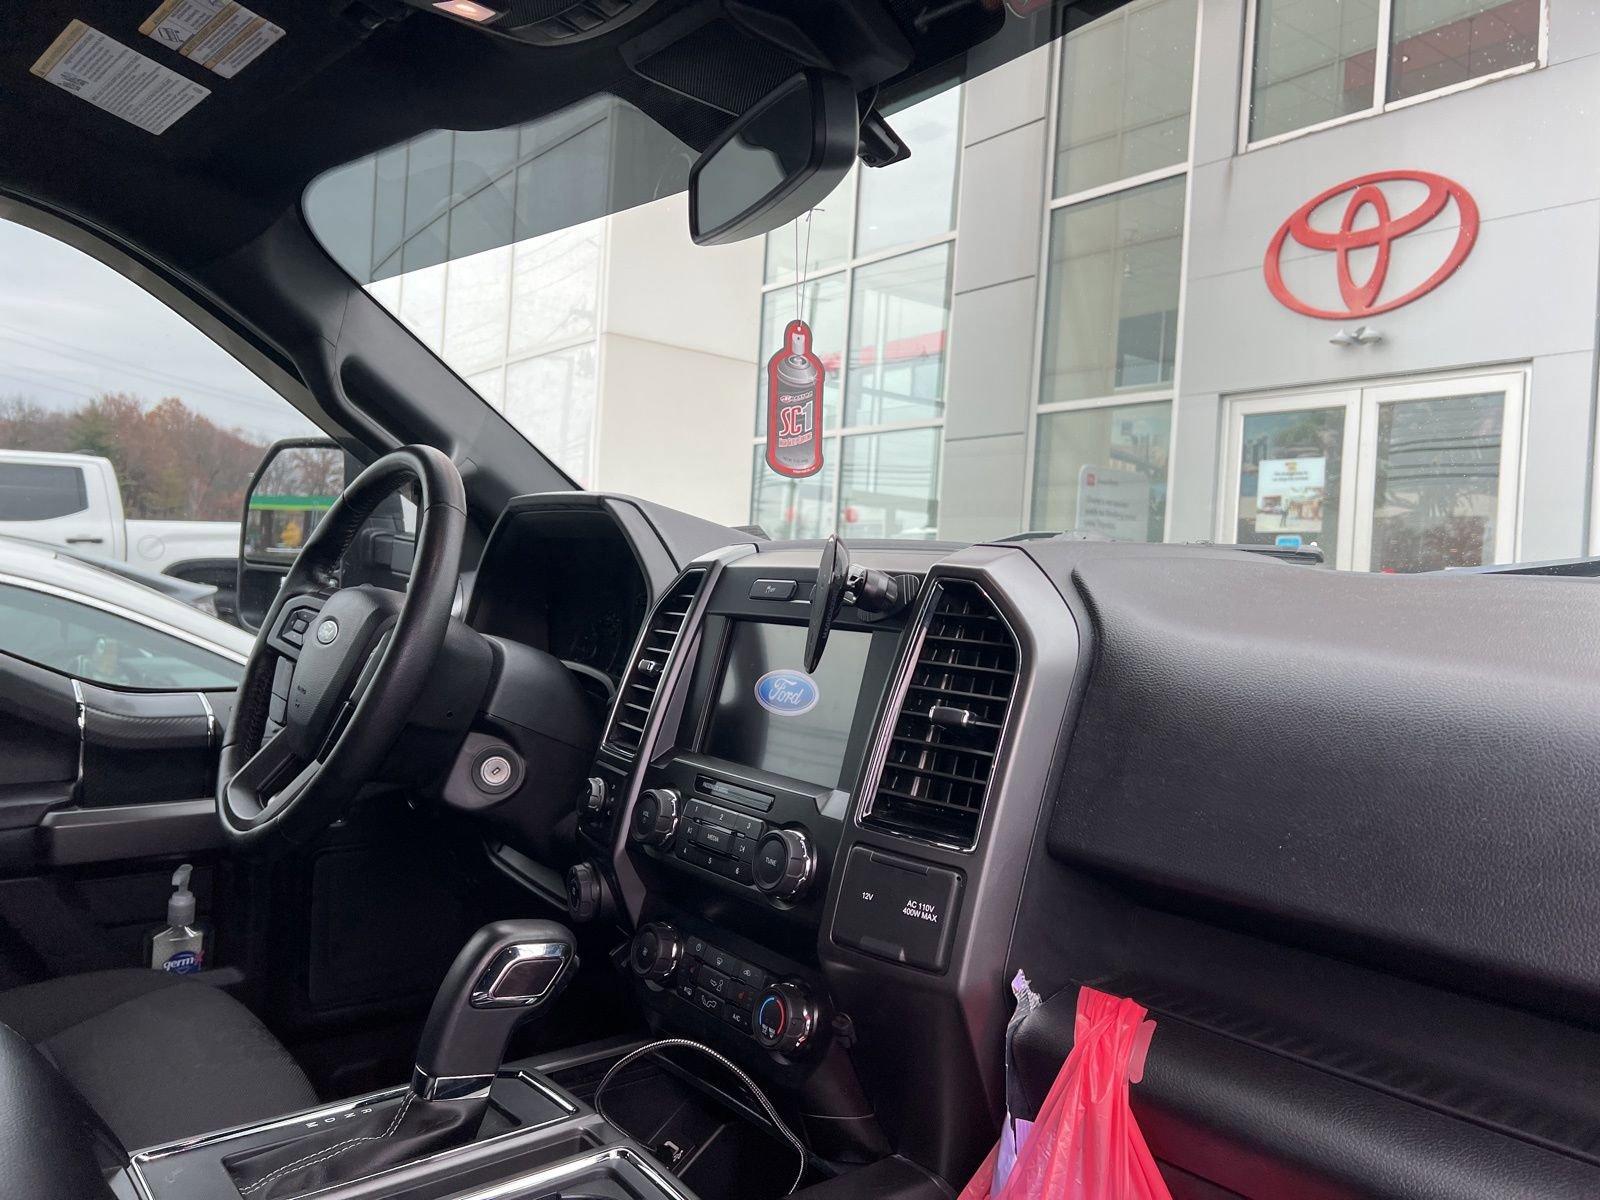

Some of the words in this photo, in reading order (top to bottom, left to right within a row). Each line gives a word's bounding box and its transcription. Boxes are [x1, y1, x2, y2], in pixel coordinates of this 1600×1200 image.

[779, 400, 813, 437] SC1
[768, 678, 804, 705] Ford
[719, 813, 724, 821] 2
[765, 856, 777, 867] TUNE
[735, 867, 740, 875] 6
[862, 892, 874, 901] 12V
[906, 900, 917, 909] AC
[918, 902, 935, 913] 110V
[902, 907, 921, 918] 400W
[921, 911, 938, 923] MAX
[732, 1013, 741, 1022] A/C
